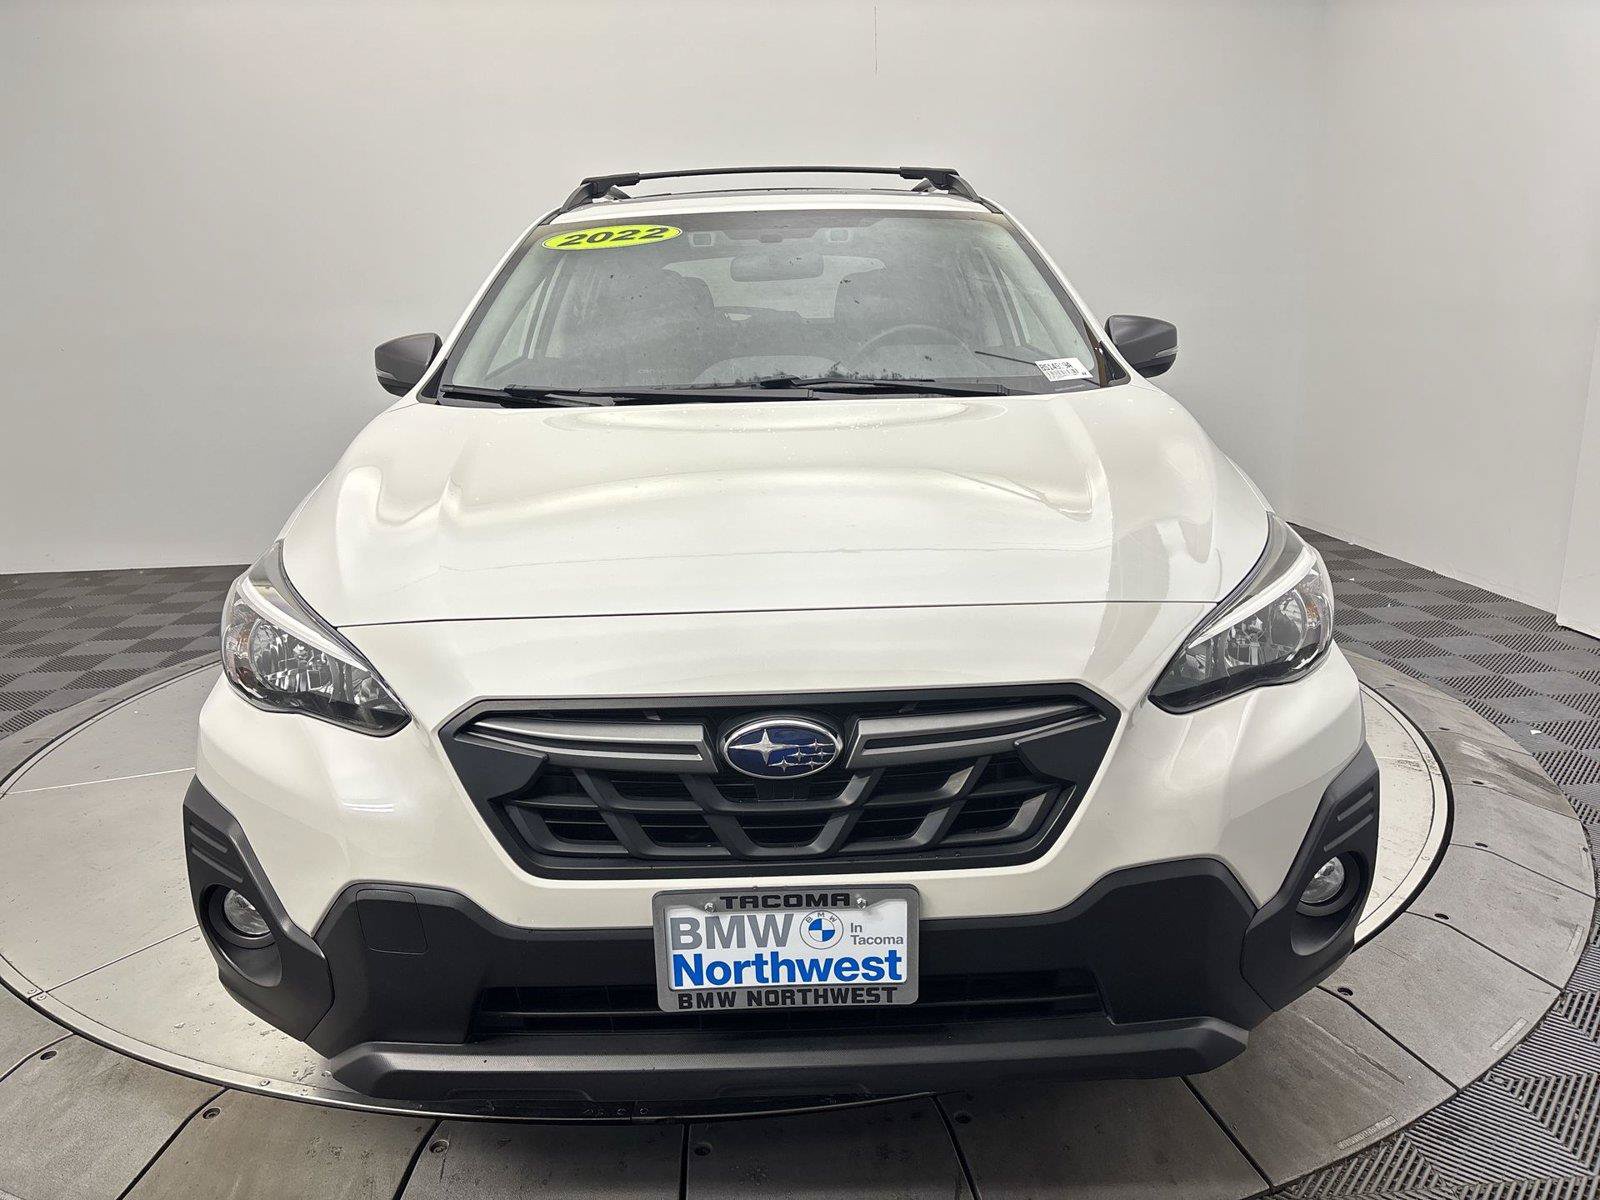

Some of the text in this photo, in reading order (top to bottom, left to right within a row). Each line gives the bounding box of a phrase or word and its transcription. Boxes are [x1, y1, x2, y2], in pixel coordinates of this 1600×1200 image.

[557, 228, 669, 247] 2022
[720, 893, 850, 909] TACOMA
[806, 912, 838, 923] BMW
[670, 914, 794, 950] BMW
[850, 922, 862, 933] In
[850, 935, 904, 945] Tacoma
[673, 950, 902, 987] Northwest
[678, 987, 897, 1010] BMW NORTHWEST
